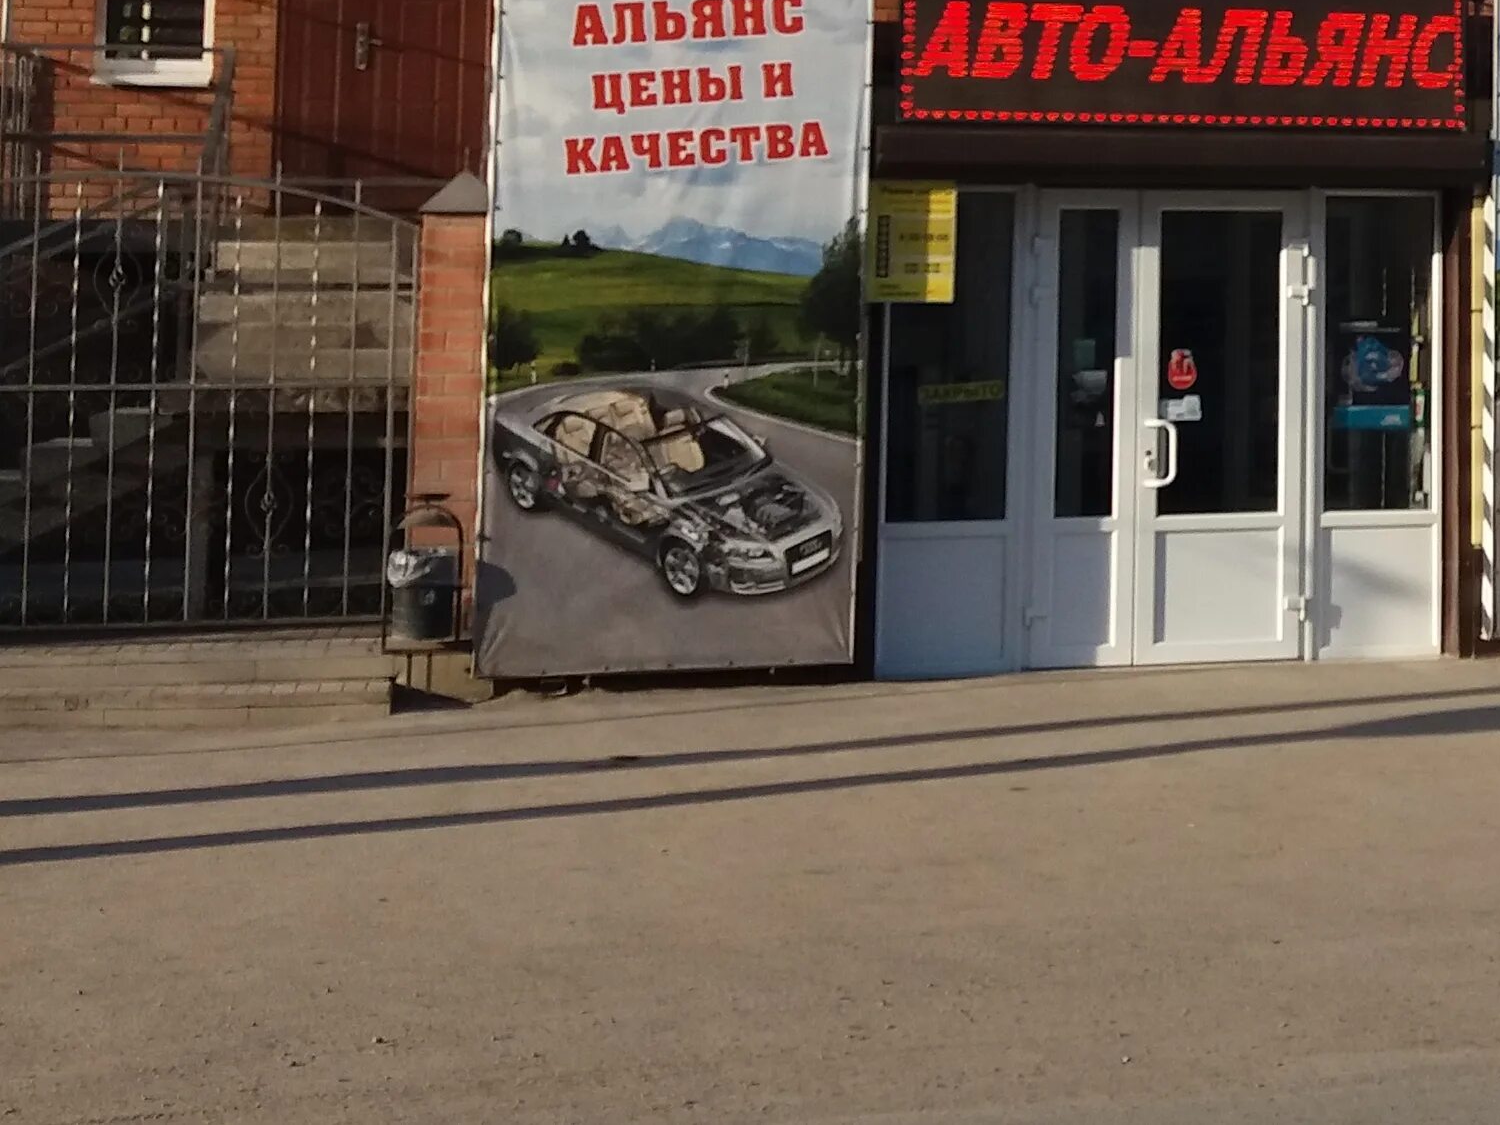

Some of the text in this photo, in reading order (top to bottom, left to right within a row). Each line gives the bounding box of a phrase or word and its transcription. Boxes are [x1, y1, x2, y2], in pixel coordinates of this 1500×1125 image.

[914, 0, 1457, 89] АВТО-АЛЬЯНС
[591, 61, 795, 115] ЦЕНЫ И
[564, 121, 829, 175] КАЧЕСТВА
